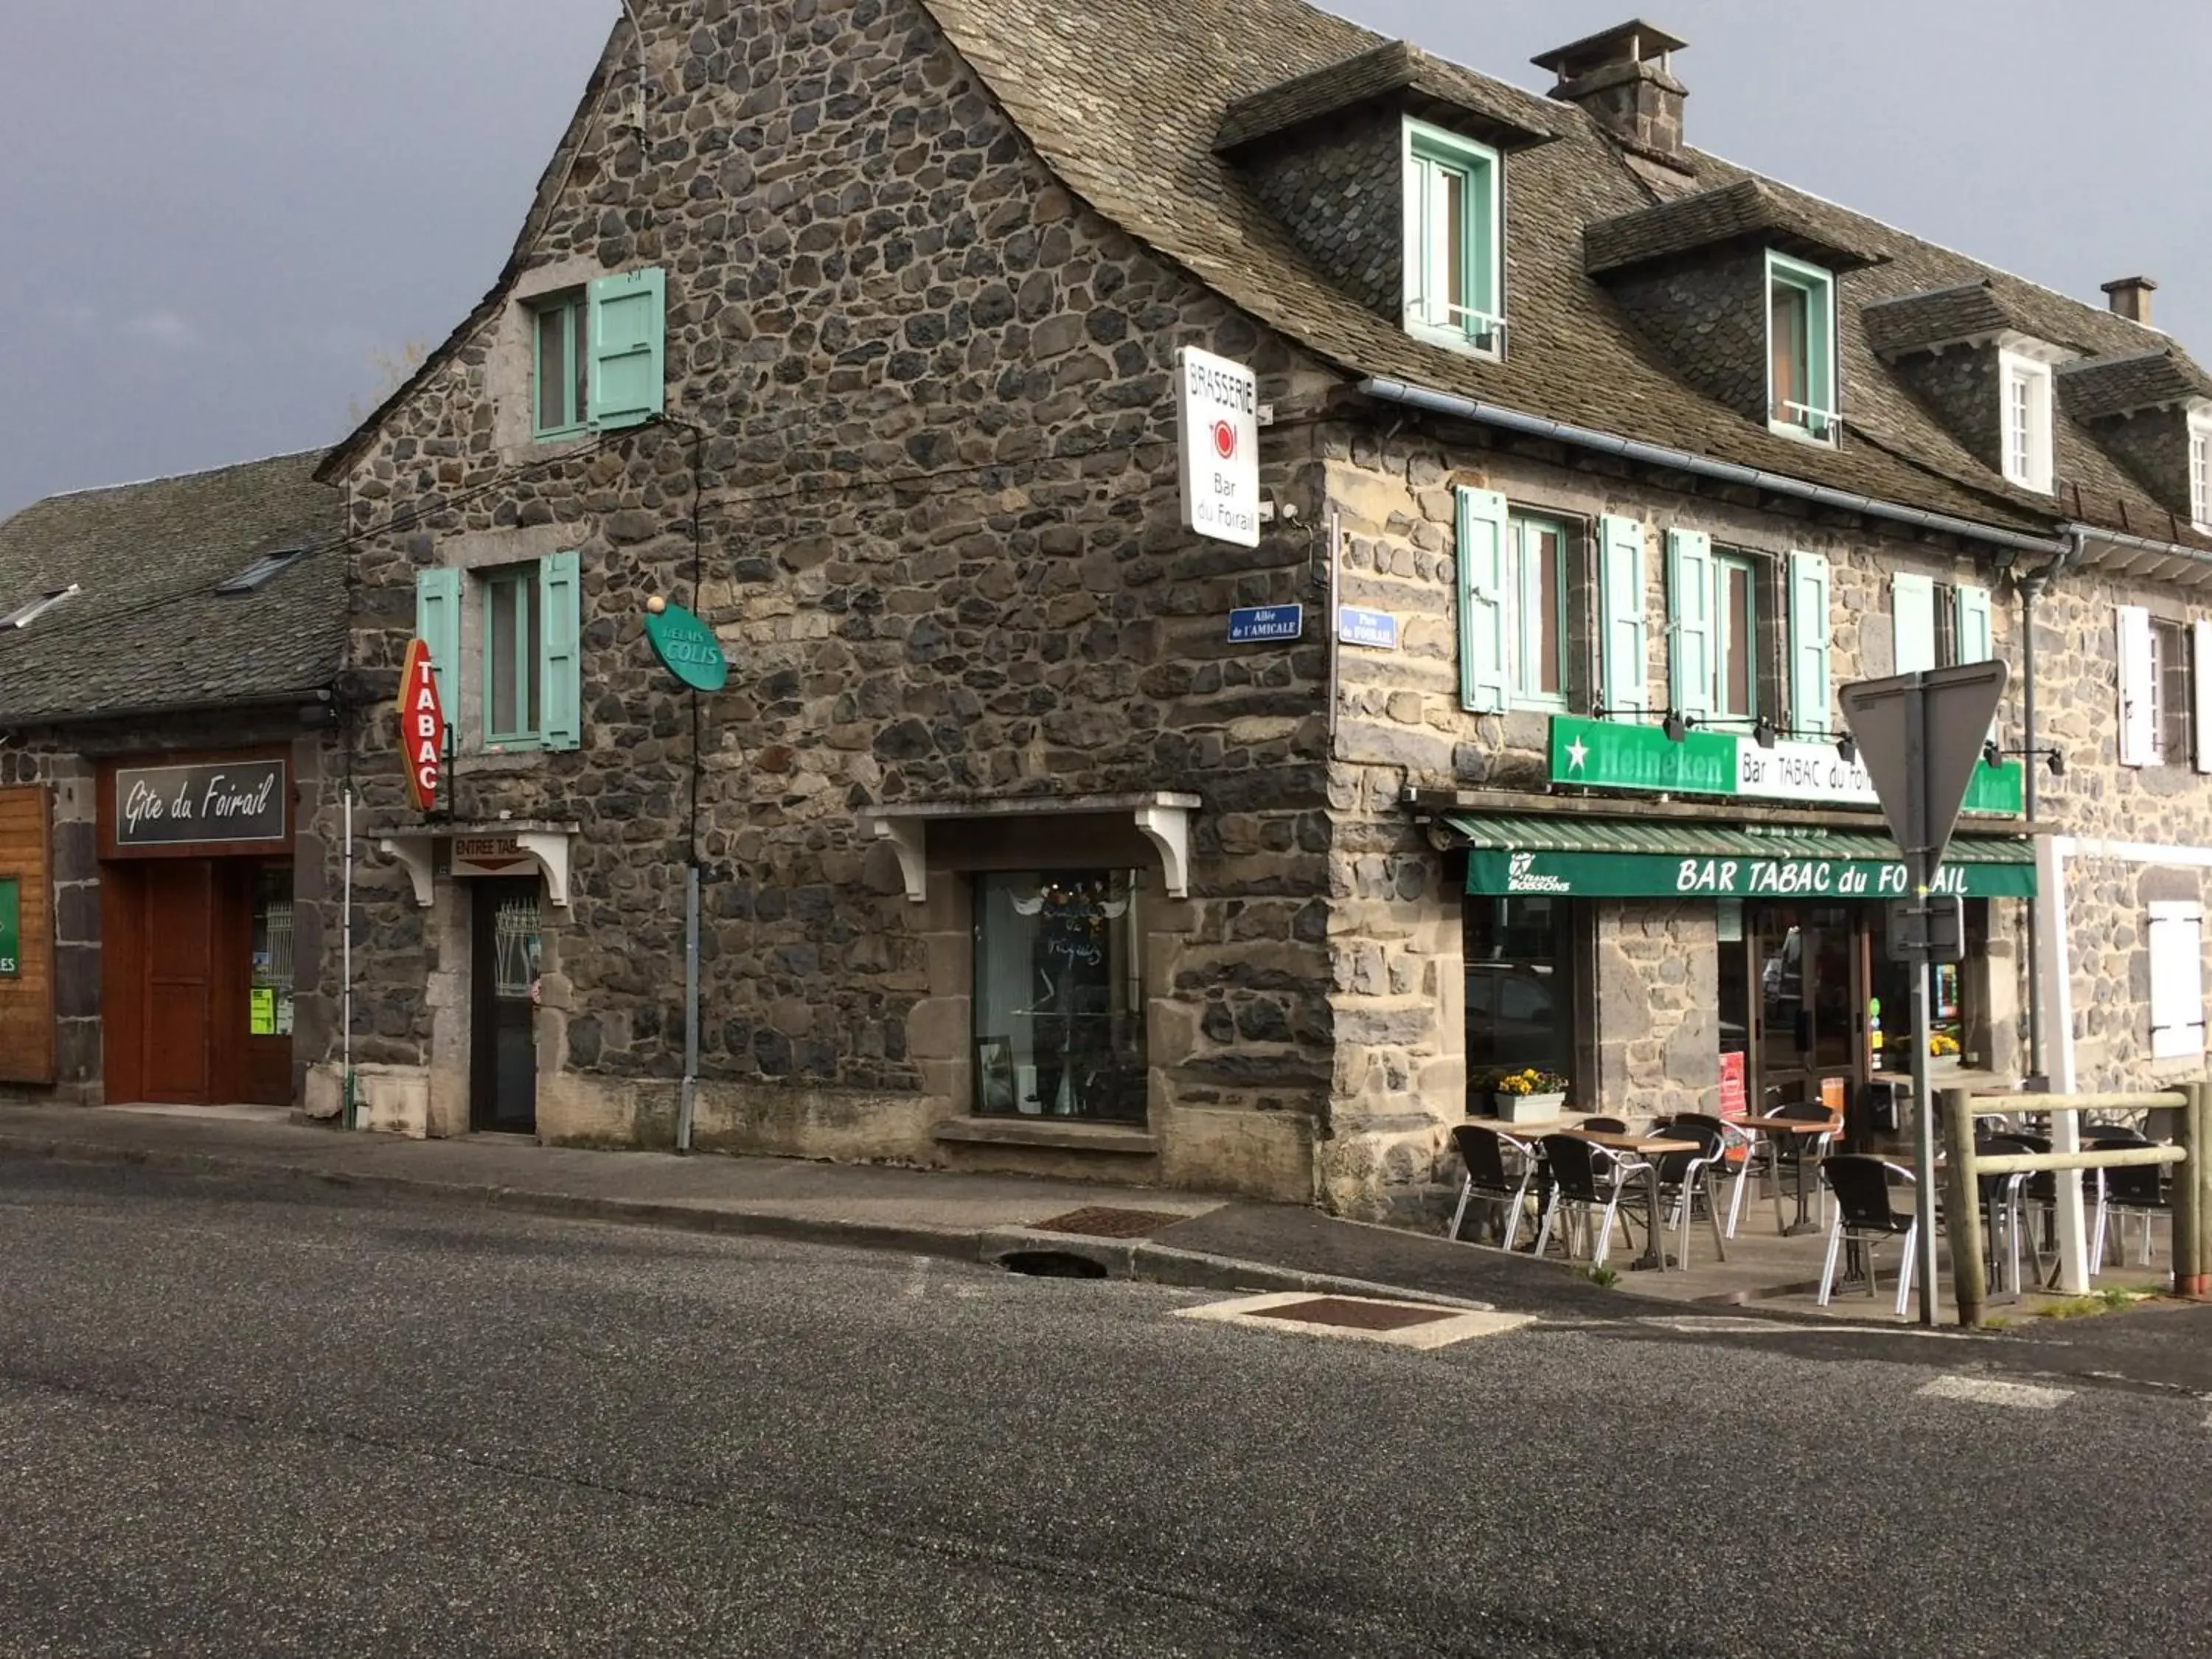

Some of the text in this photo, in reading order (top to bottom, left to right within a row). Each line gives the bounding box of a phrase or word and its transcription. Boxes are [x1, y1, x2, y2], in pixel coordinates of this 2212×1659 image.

[1189, 362, 1253, 415] BRASSERIE
[1214, 472, 1236, 497] Bar
[1197, 500, 1254, 532] du Foirail
[666, 641, 717, 665] COLIS
[417, 661, 437, 790] TABAC
[1599, 734, 1723, 784] Heineken
[1742, 752, 1766, 783] Bar
[1778, 757, 1820, 787] TABAC
[1829, 760, 1844, 789] du
[125, 772, 275, 835] Gîte du Foirail
[1508, 879, 1571, 892] BOISSONS
[1676, 858, 1969, 894] BAR TABAC du FOAIL
